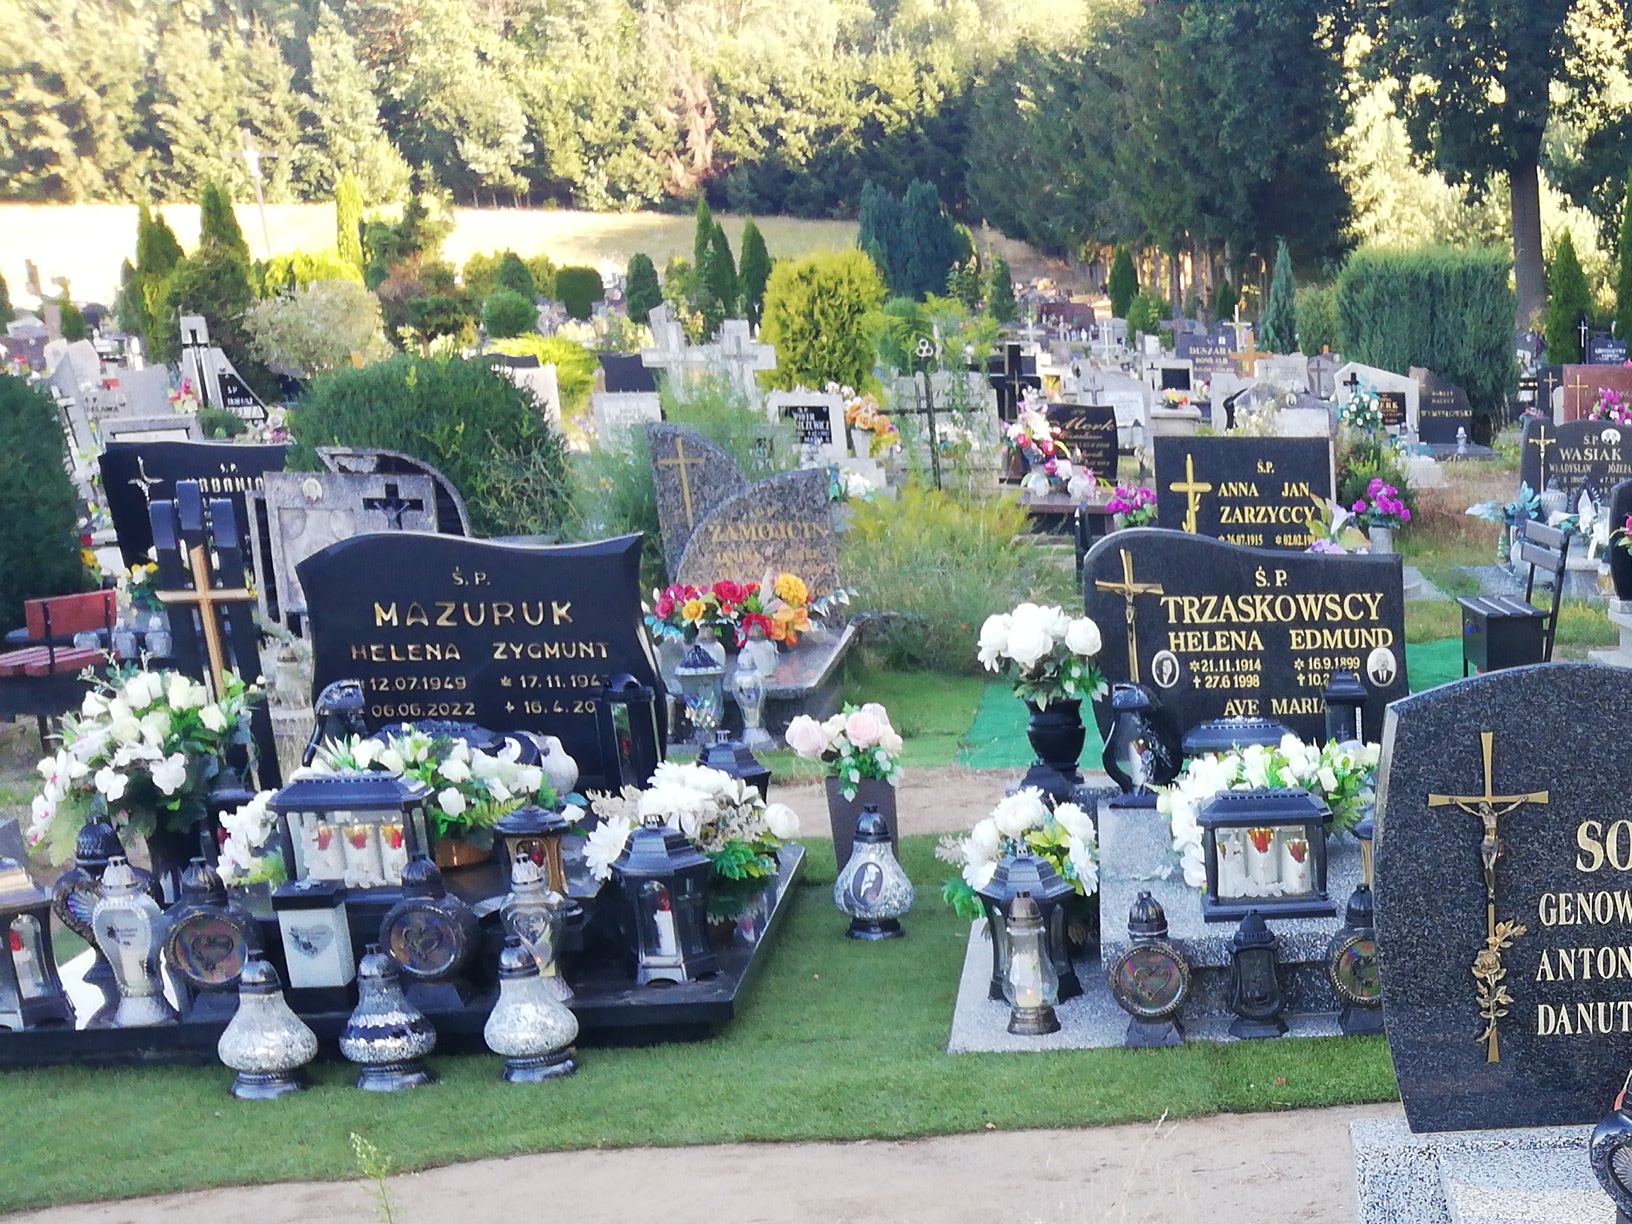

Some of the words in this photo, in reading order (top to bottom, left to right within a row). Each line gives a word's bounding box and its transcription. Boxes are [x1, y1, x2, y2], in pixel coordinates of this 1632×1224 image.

[1559, 448, 1622, 461] WASIAK
[1549, 463, 1593, 473] WŁADYSŁAW
[1608, 462, 1632, 474] JÓZEFA
[1218, 482, 1259, 497] ANNA
[1281, 482, 1310, 497] JAN
[1220, 506, 1315, 524] ZARZYCCY
[374, 601, 573, 627] MAZURUK
[1160, 593, 1384, 624] TRZASKOWSCY
[1168, 630, 1264, 653] HELENA
[1289, 628, 1394, 650] EDMUND
[351, 643, 461, 662] HELENA
[493, 641, 609, 660] ZYGMUNT
[1201, 658, 1262, 673] 21.11.1914
[1308, 656, 1361, 670] 16.9.1899
[370, 675, 467, 692] 12.07.1949
[520, 673, 608, 688] 17.11.194
[371, 701, 476, 718] 06.06.2022
[1224, 698, 1260, 716] AVE
[1271, 697, 1332, 715] MARIA
